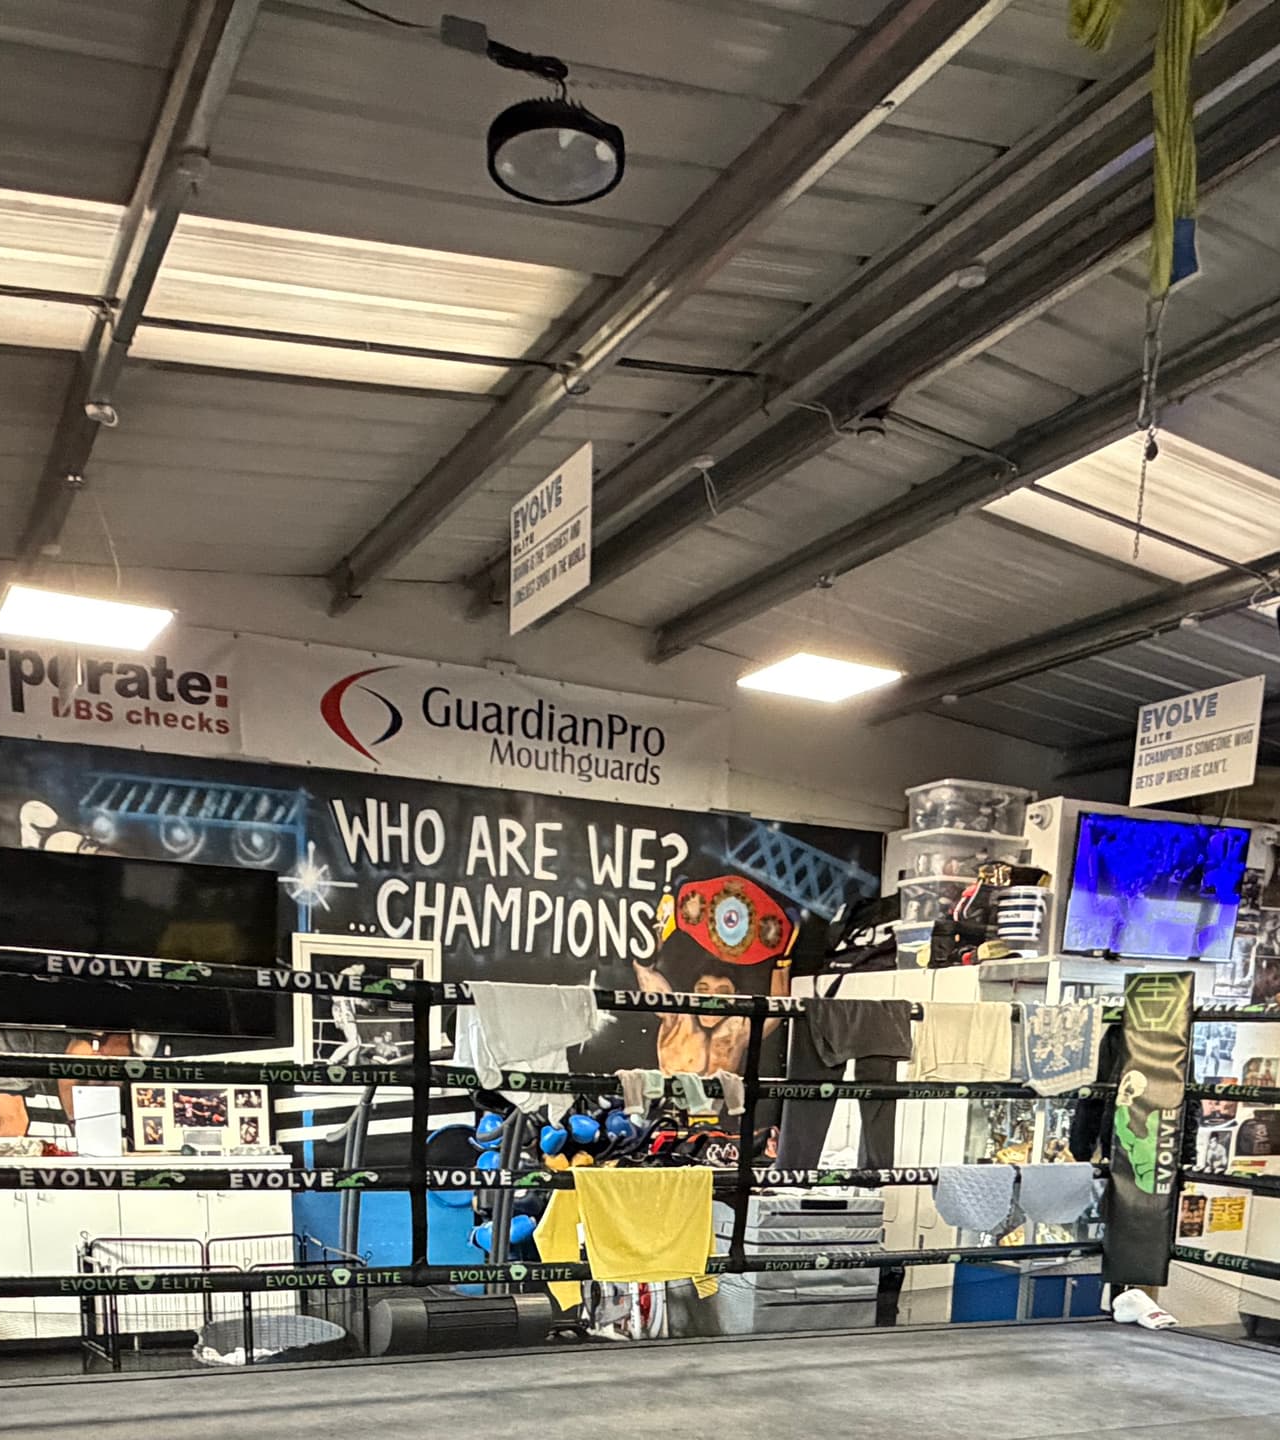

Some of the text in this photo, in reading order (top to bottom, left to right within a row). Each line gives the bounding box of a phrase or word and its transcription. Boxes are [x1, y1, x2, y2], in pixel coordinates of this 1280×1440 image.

[513, 474, 562, 541] EVOLVE
[126, 706, 230, 735] checks
[1141, 693, 1218, 733] EVOLVE
[422, 686, 666, 757] GuardianPro
[1140, 731, 1173, 746] ELITE
[1144, 750, 1184, 766] CHAMPION
[1194, 734, 1233, 755] SOMEONE
[1234, 729, 1254, 748] WHO
[489, 738, 661, 785] Mouthguards
[1135, 774, 1154, 789] GETS
[1155, 771, 1165, 786] UP
[1166, 766, 1189, 783] WHEN
[1190, 763, 1201, 779] HE
[332, 798, 689, 893] WHO ARE WE?
[47, 955, 163, 979] EVOLVE
[257, 969, 362, 992] EVOLVE
[615, 990, 701, 1007] EVOLVE
[49, 1063, 205, 1080] EVOLVE ELITE
[259, 1069, 401, 1084] EVOLVE ELITE
[531, 1080, 572, 1092] ELITE
[769, 1087, 872, 1099] EVOLVE ELITE
[1156, 1108, 1177, 1195] EVOLVE
[20, 1171, 136, 1187] EVOLVE
[229, 1172, 335, 1188] EVOLVE
[426, 1170, 513, 1185] VOLVE
[753, 1169, 819, 1184] VOLVE
[879, 1168, 938, 1183] EVOLV
[1218, 1257, 1249, 1270] ELITE
[266, 1271, 402, 1287] EVOLVE ELITE
[449, 1268, 573, 1282] EVOLVE ELITE
[60, 1276, 213, 1291] EVOLVE ELITE
